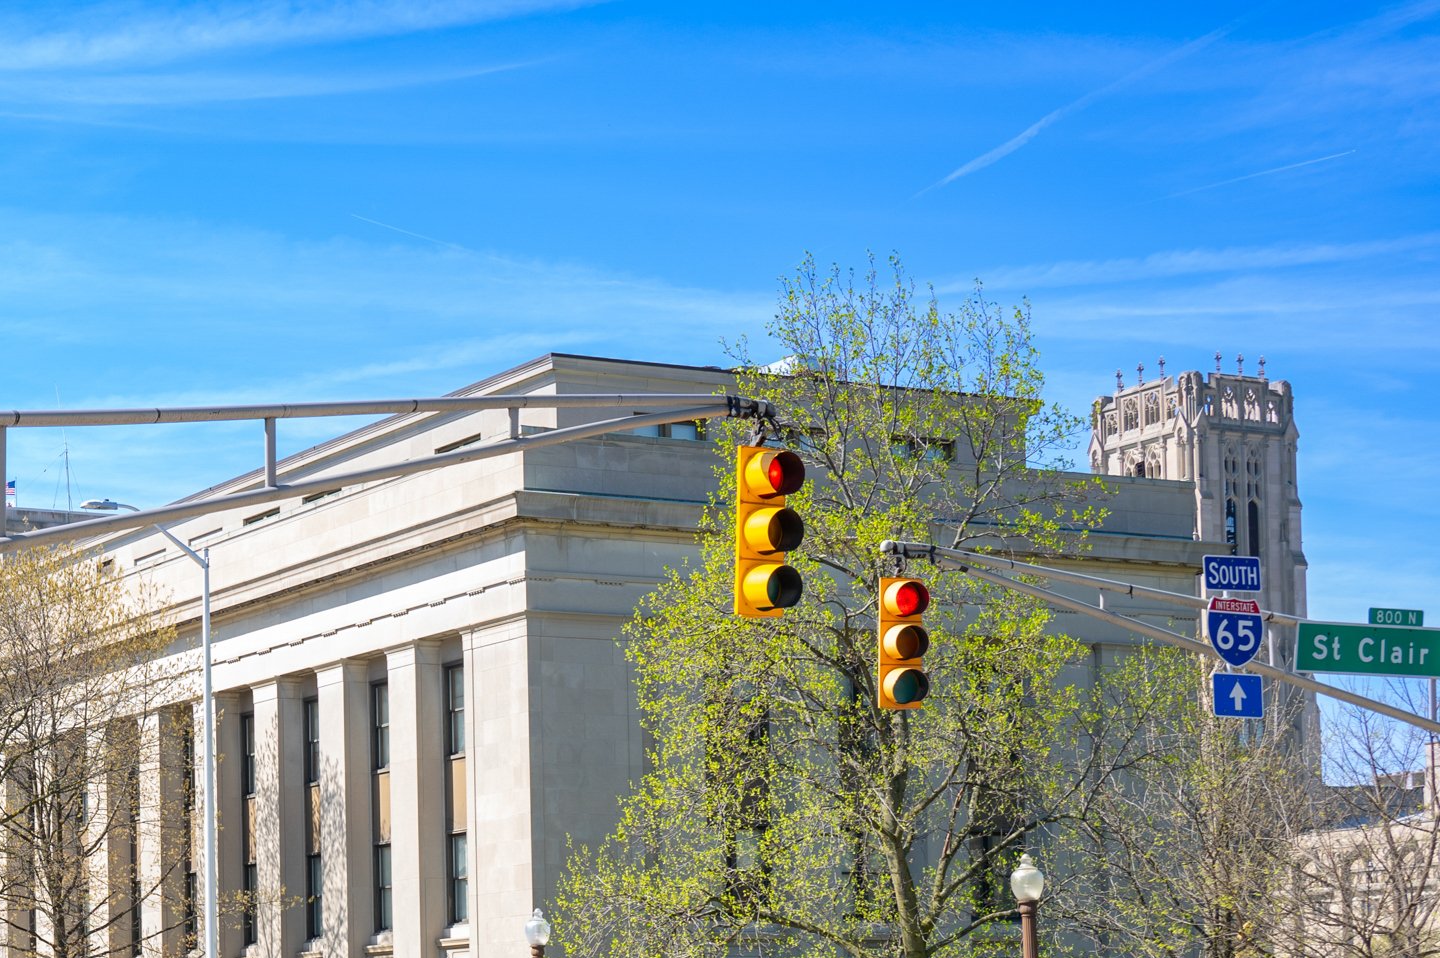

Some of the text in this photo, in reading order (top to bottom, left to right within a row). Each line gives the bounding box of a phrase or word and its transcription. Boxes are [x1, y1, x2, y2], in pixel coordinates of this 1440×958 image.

[1209, 562, 1257, 585] SOUTH
[1215, 601, 1255, 613] INTERSTATE
[1376, 610, 1416, 624] 800 N
[1216, 618, 1255, 651] 65
[1312, 635, 1429, 665] St Clair
